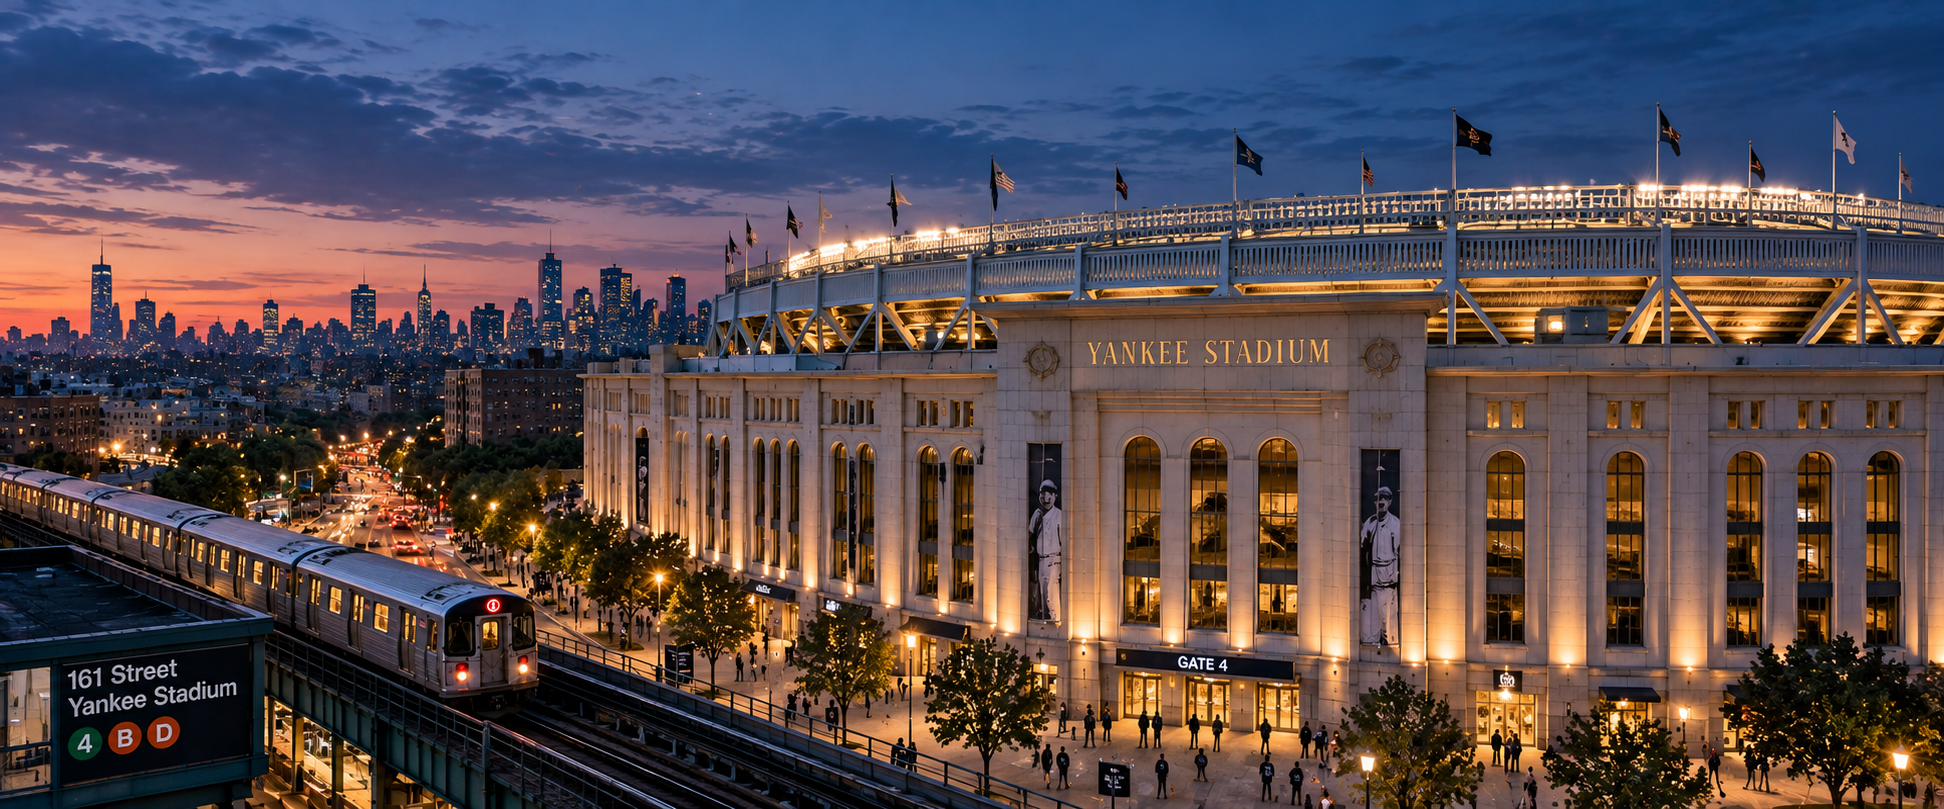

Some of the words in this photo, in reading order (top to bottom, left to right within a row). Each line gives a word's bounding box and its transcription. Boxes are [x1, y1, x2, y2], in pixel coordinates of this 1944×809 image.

[1087, 340, 1189, 365] YANKEE
[1204, 339, 1331, 365] STADIUM
[67, 667, 102, 690] 161
[110, 659, 178, 685] Street
[1177, 655, 1215, 671] GATE
[1218, 658, 1228, 672] 4
[68, 692, 147, 717] Yankee
[154, 680, 238, 706] Stadium
[77, 733, 93, 754] 4
[117, 728, 134, 748] B
[156, 723, 173, 743] D
